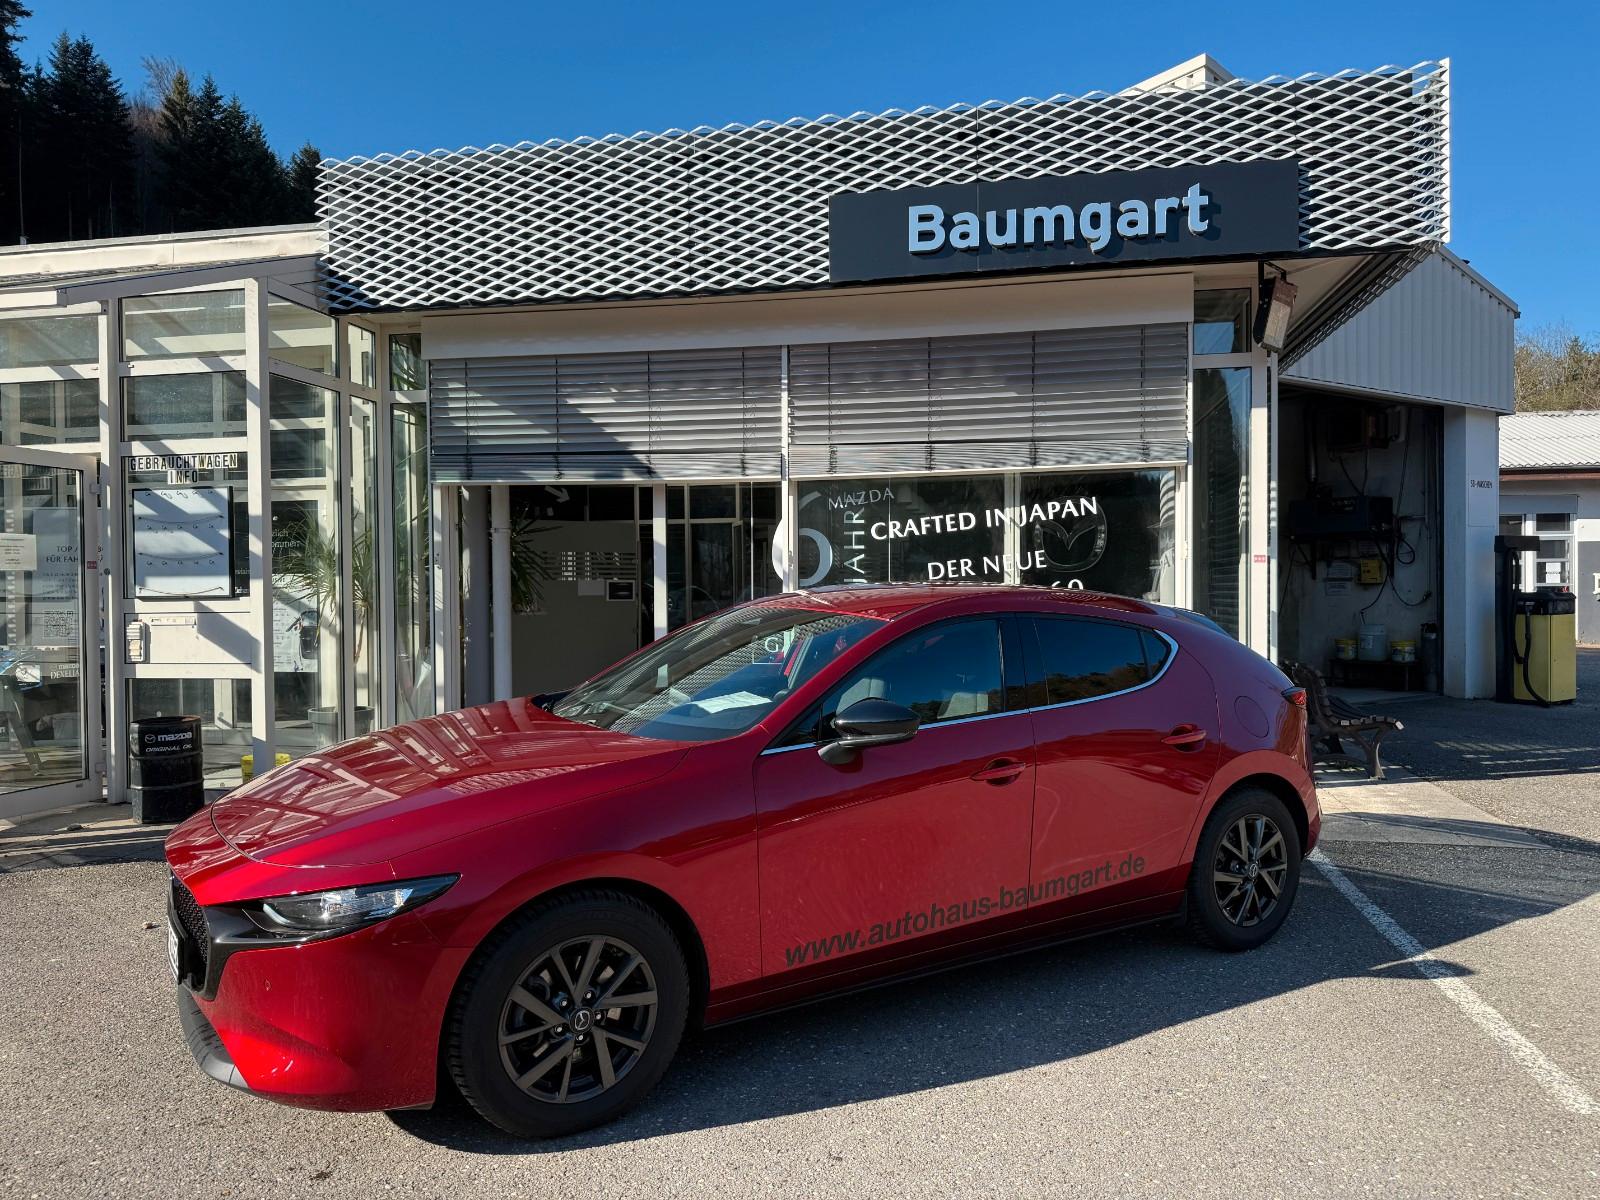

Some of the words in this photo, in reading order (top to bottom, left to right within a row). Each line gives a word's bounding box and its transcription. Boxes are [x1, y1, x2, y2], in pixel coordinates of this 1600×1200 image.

[908, 182, 1209, 255] Baumgart
[130, 453, 238, 471] GEBRAUCHTWAGEN
[169, 470, 199, 484] INFO
[828, 487, 895, 511] MAZDA
[870, 511, 977, 541] CRAFTED
[985, 508, 1012, 528] IN
[1017, 496, 1098, 527] JAPAN
[46, 554, 61, 563] FÜR
[56, 545, 73, 553] TOP
[927, 558, 977, 580] DER
[982, 549, 1048, 575] NEUE
[157, 731, 193, 742] mazda
[785, 853, 1146, 968] www.autohaus-baumgart.de
